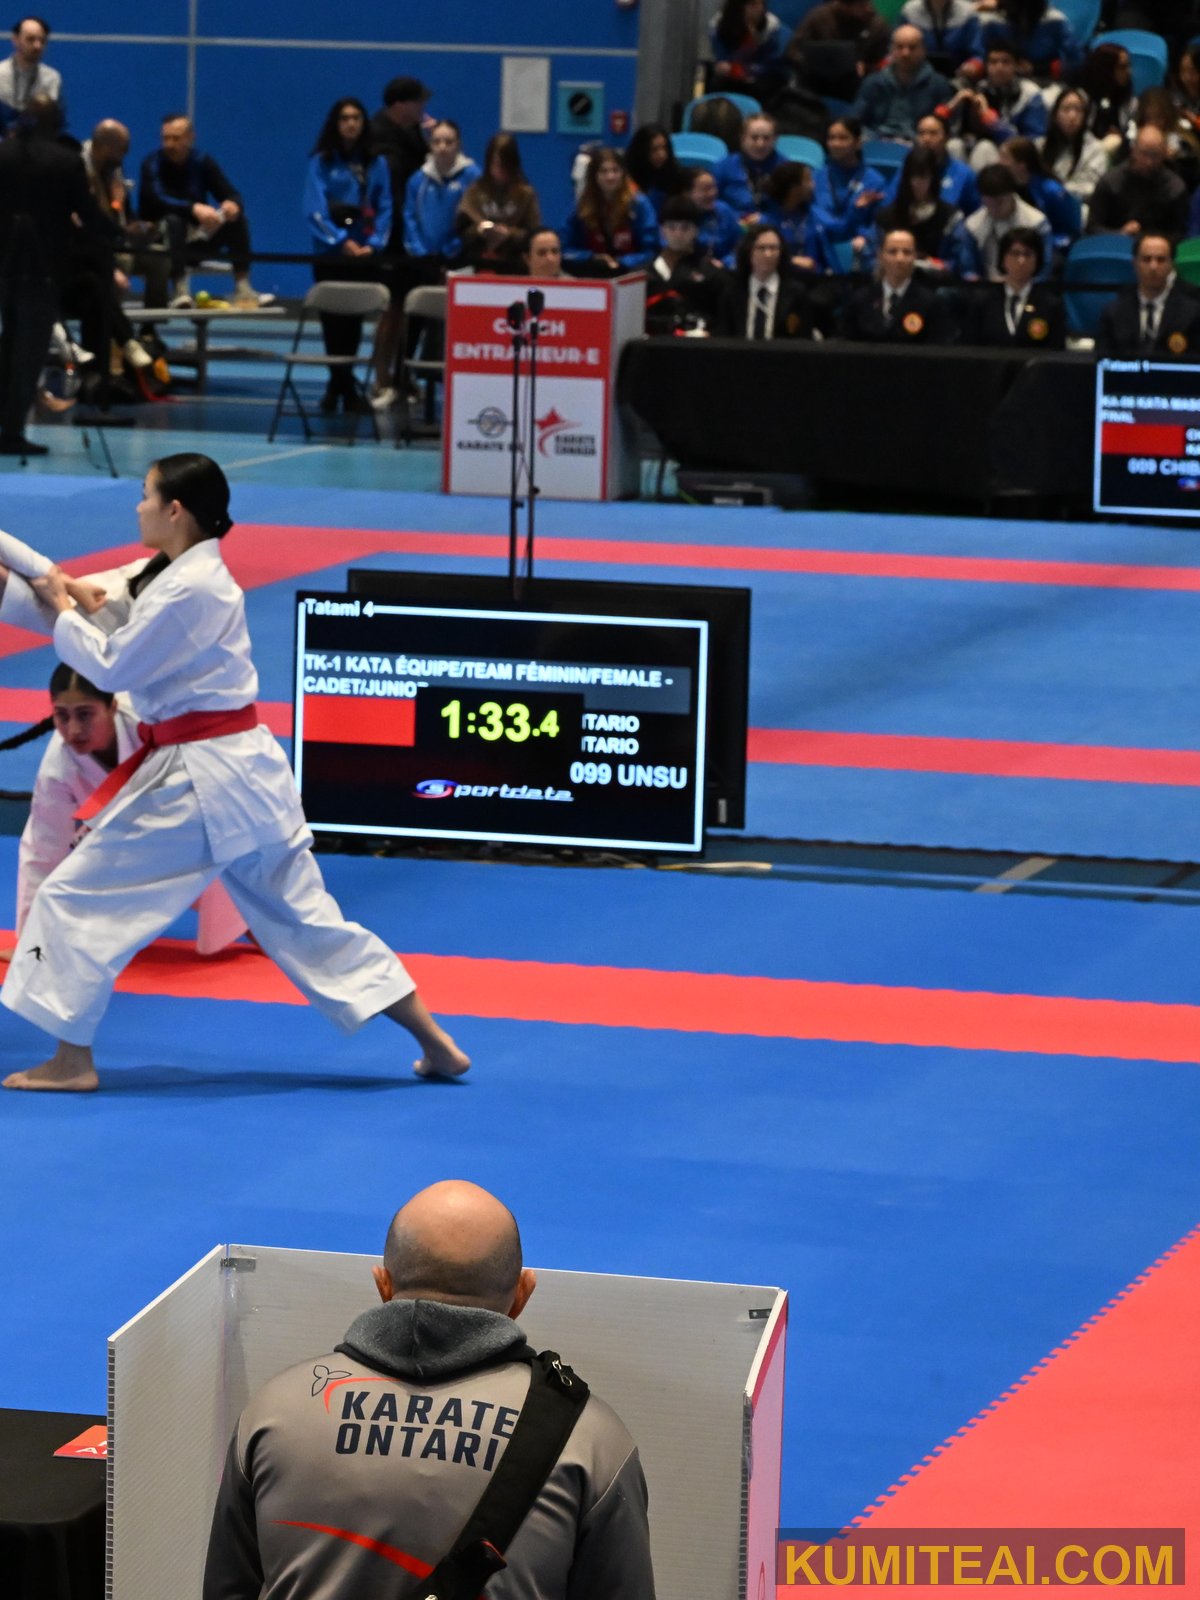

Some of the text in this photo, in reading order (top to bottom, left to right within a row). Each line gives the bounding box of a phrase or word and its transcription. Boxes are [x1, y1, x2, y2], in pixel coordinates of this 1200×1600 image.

[304, 598, 375, 617] Tatami 4
[304, 654, 341, 672] TK-1
[345, 656, 393, 674] KATA
[303, 676, 429, 698] CADET/JUNIO
[441, 700, 560, 742] 1:33.4
[570, 761, 688, 789] 099 UNSU
[341, 1391, 520, 1439] KARATE
[335, 1423, 499, 1472] ONTARI
